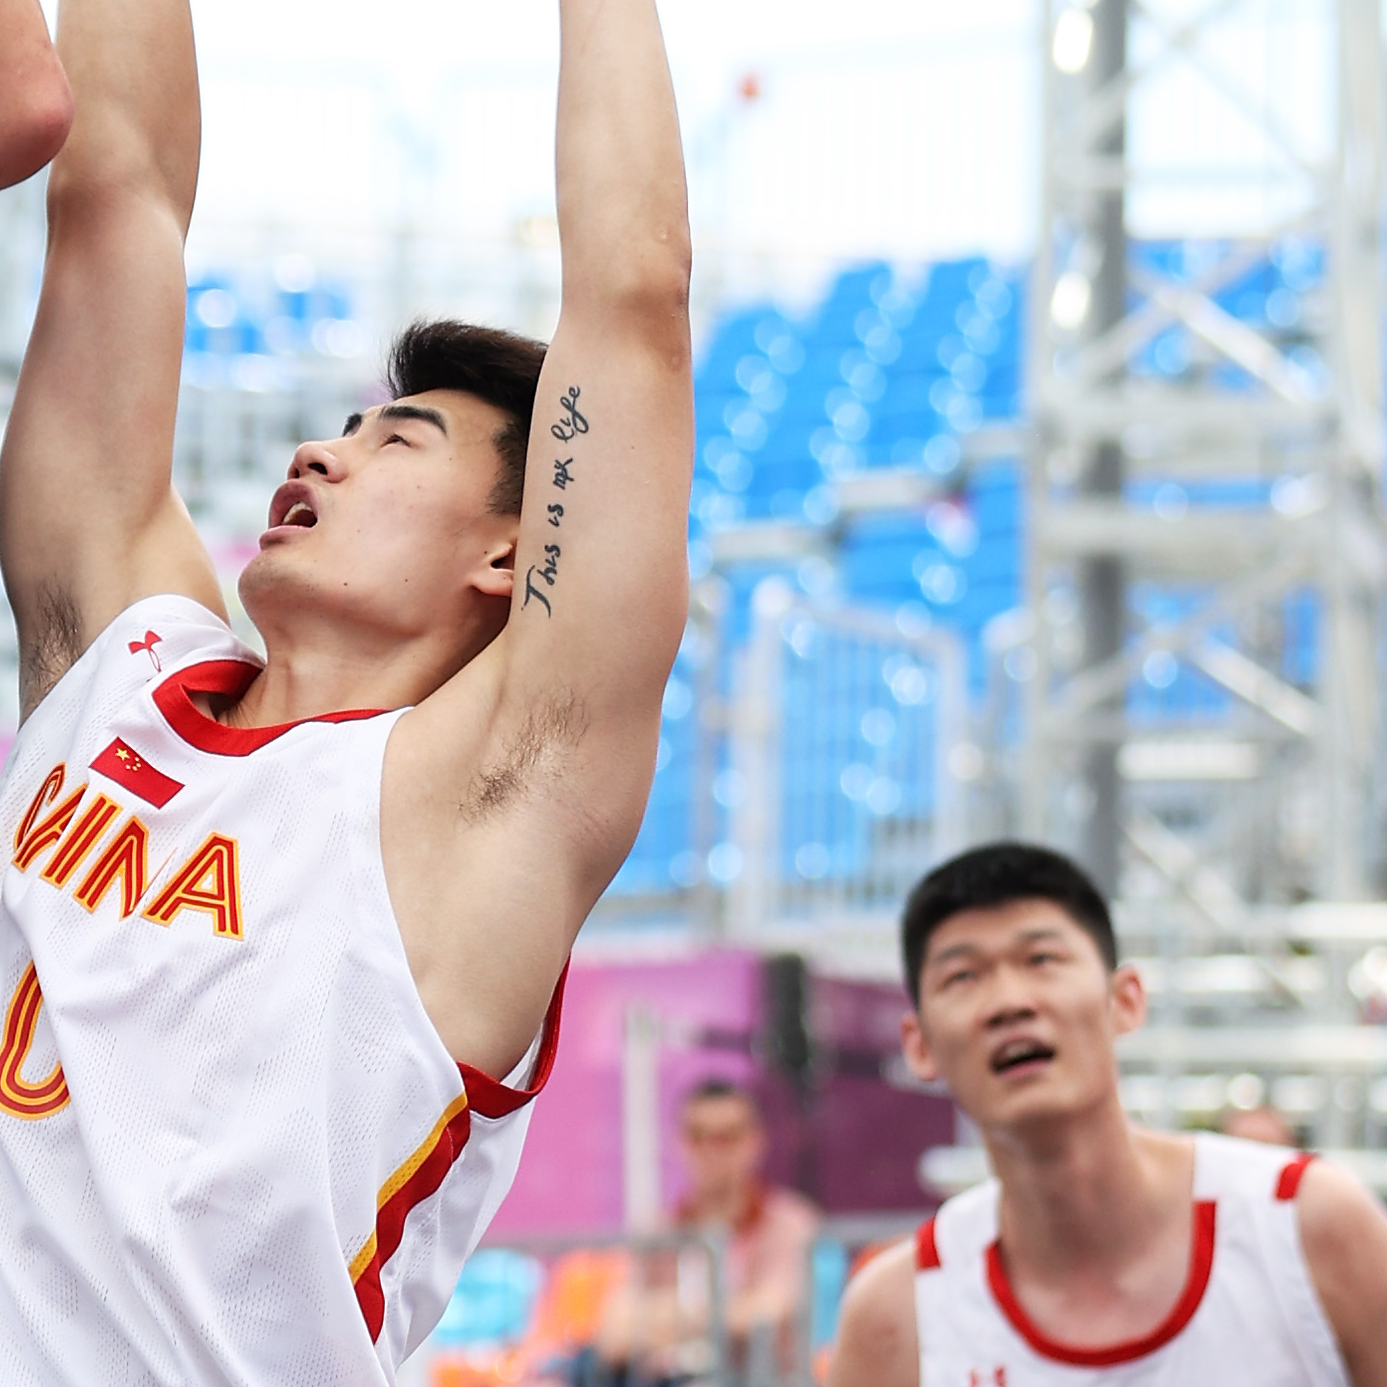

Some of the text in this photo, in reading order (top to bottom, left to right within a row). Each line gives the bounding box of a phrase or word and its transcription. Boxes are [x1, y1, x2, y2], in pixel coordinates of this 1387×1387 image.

[550, 384, 590, 444] life
[546, 503, 565, 527] is
[520, 544, 562, 618] This
